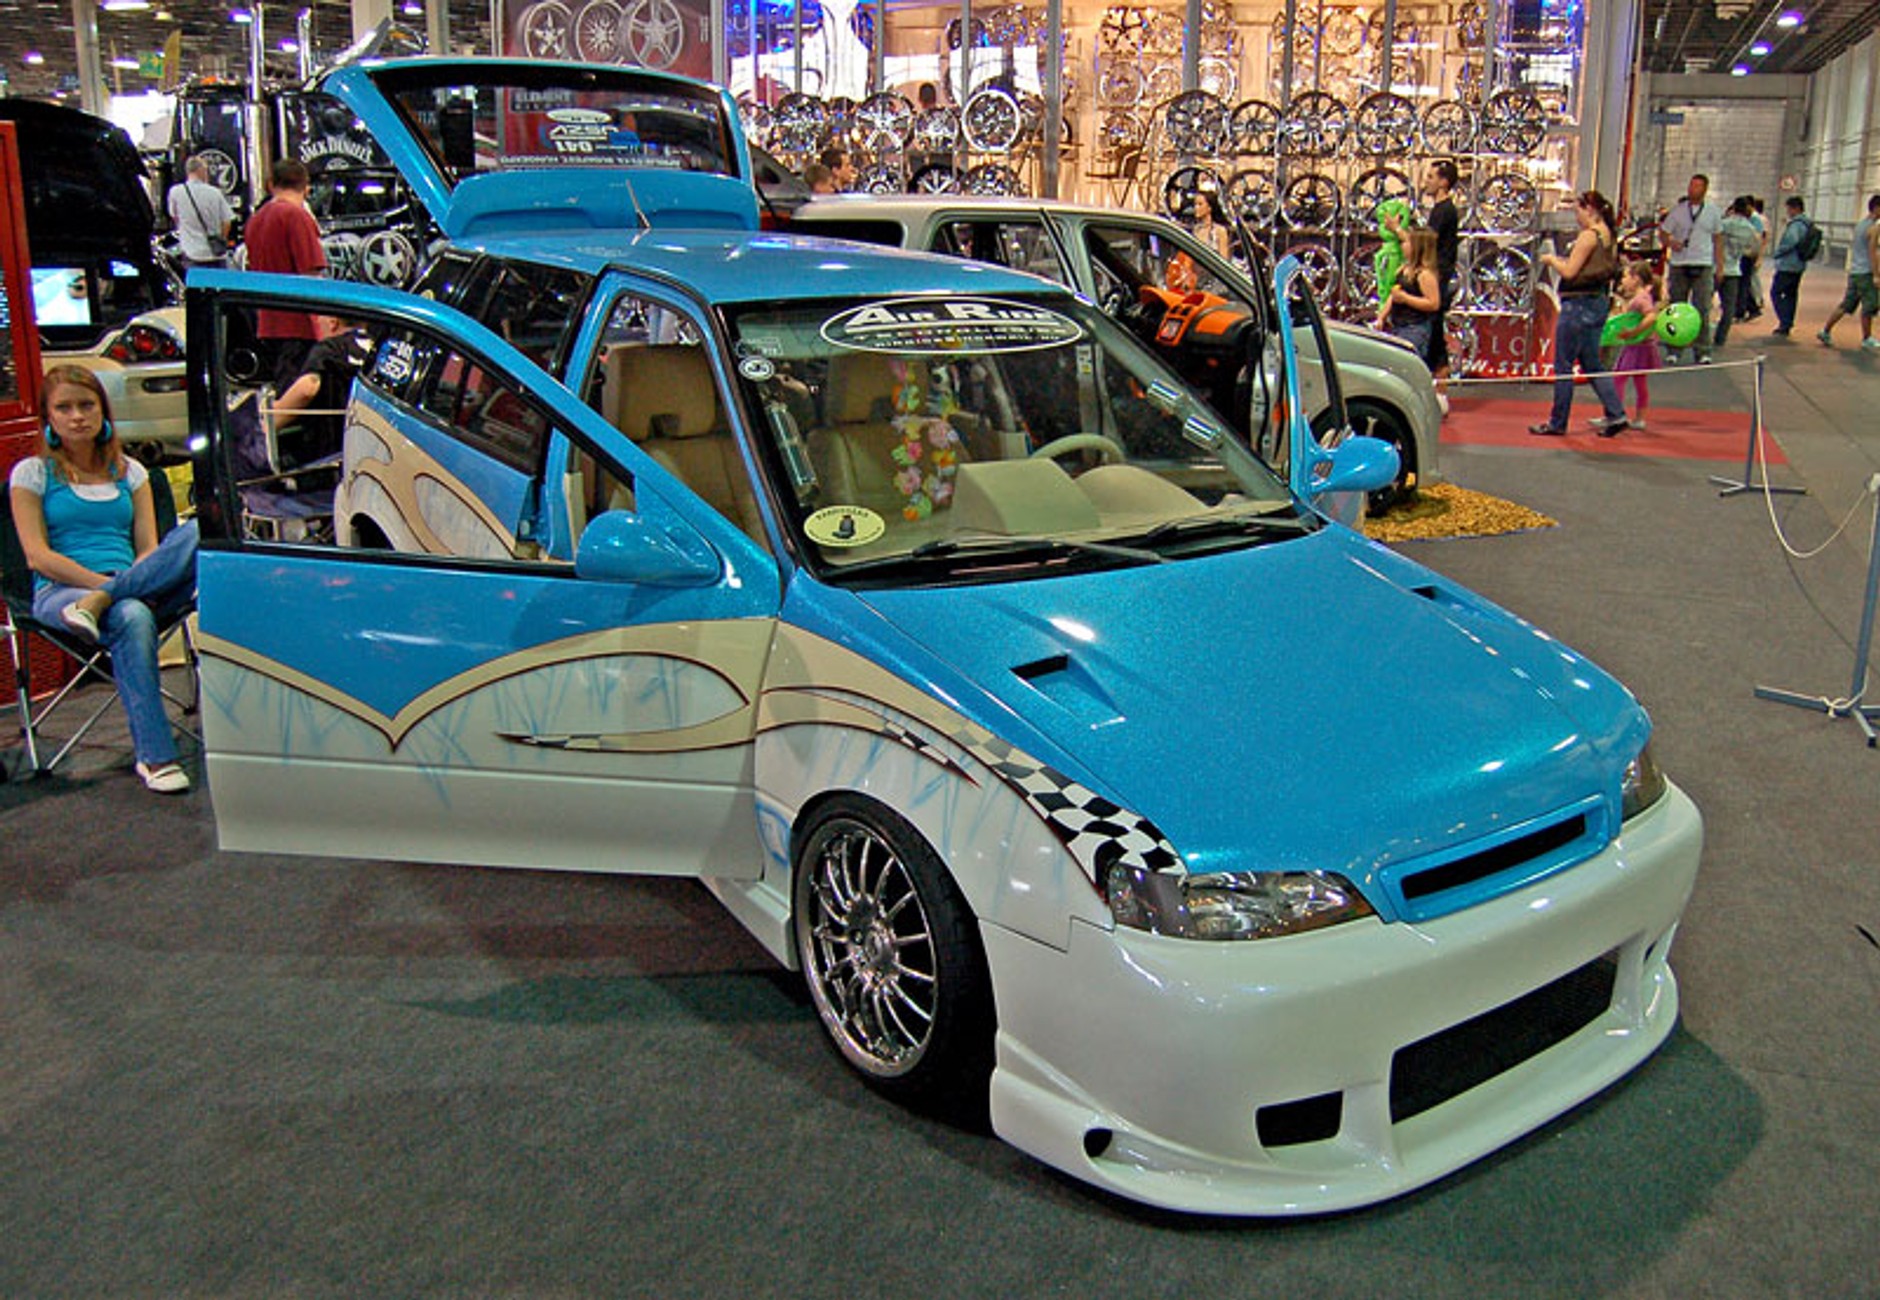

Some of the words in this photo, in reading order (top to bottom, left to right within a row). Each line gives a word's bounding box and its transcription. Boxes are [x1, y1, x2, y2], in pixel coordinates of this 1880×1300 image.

[299, 140, 328, 163] JACK
[326, 135, 373, 165] DANIEL'S
[846, 306, 938, 326] AIR
[944, 303, 1056, 320] RIDE
